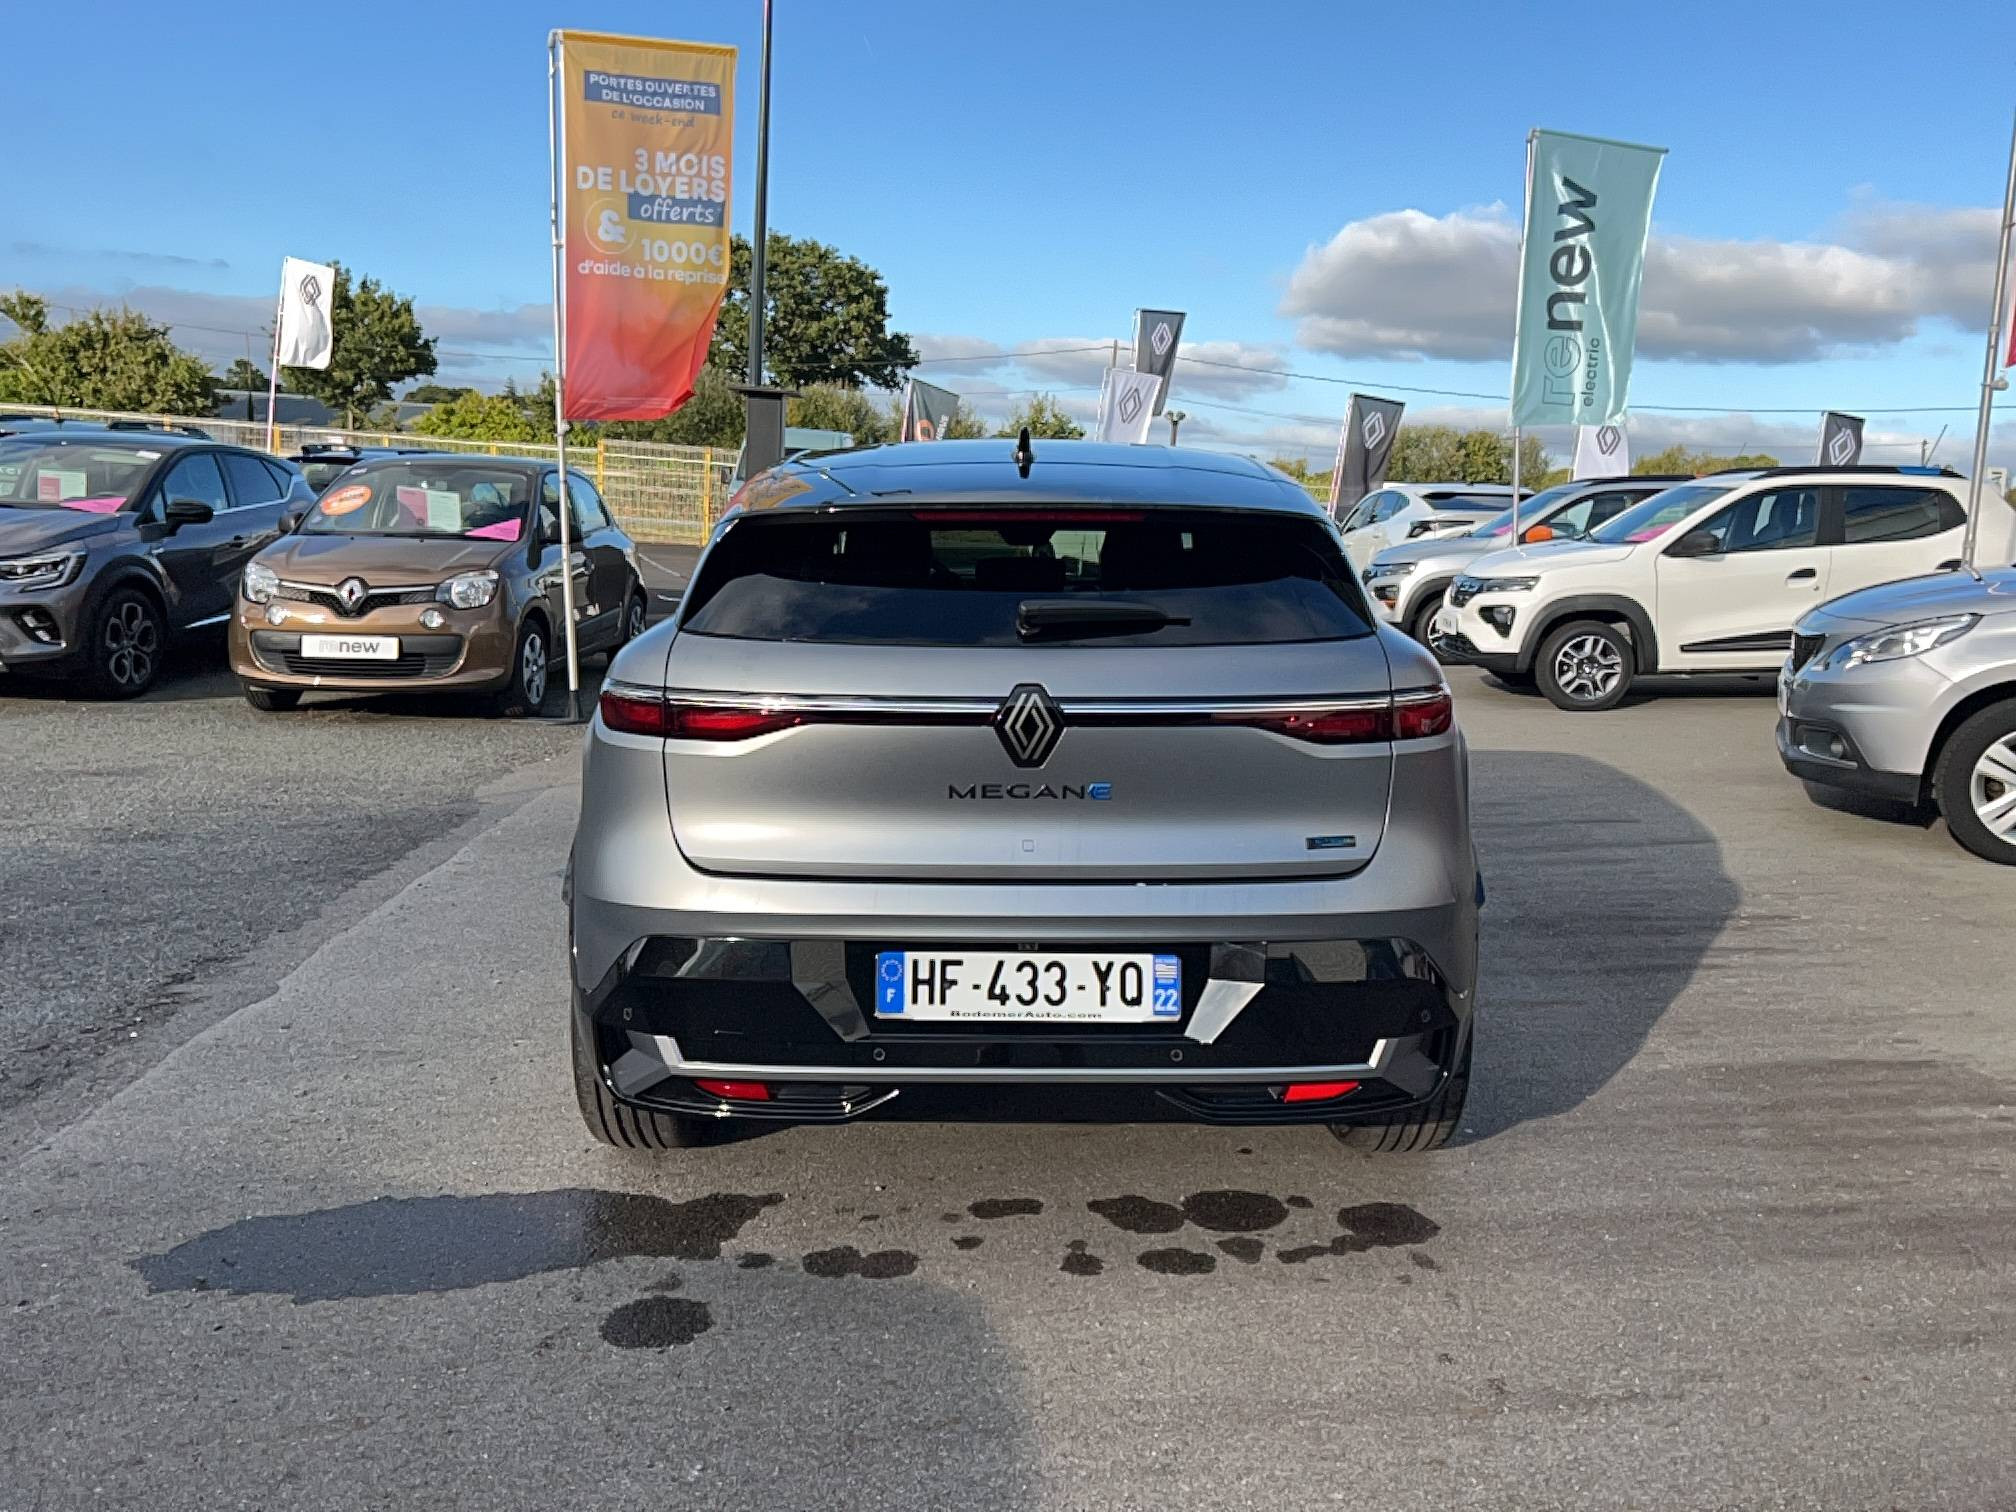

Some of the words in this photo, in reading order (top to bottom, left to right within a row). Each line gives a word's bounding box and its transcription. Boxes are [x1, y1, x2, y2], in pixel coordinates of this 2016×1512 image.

[589, 73, 642, 91] PORTES
[644, 81, 716, 98] OUVERTES
[601, 90, 619, 102] DE
[622, 93, 705, 111] L'OCCASION
[631, 112, 695, 128] week-end
[635, 148, 648, 171] 3
[655, 152, 725, 179] MOIS
[576, 165, 612, 191] DE
[619, 170, 725, 203] LOYERS
[597, 209, 626, 243] &
[642, 239, 724, 266] 1000€
[578, 259, 630, 277] d'aide
[633, 265, 645, 278] à
[648, 266, 664, 279] la
[668, 269, 727, 285] reprise
[1542, 176, 1598, 406] renew
[1583, 337, 1600, 407] electric
[948, 782, 1113, 800] MEGANE
[886, 987, 897, 1003] F
[1155, 988, 1178, 1011] 22
